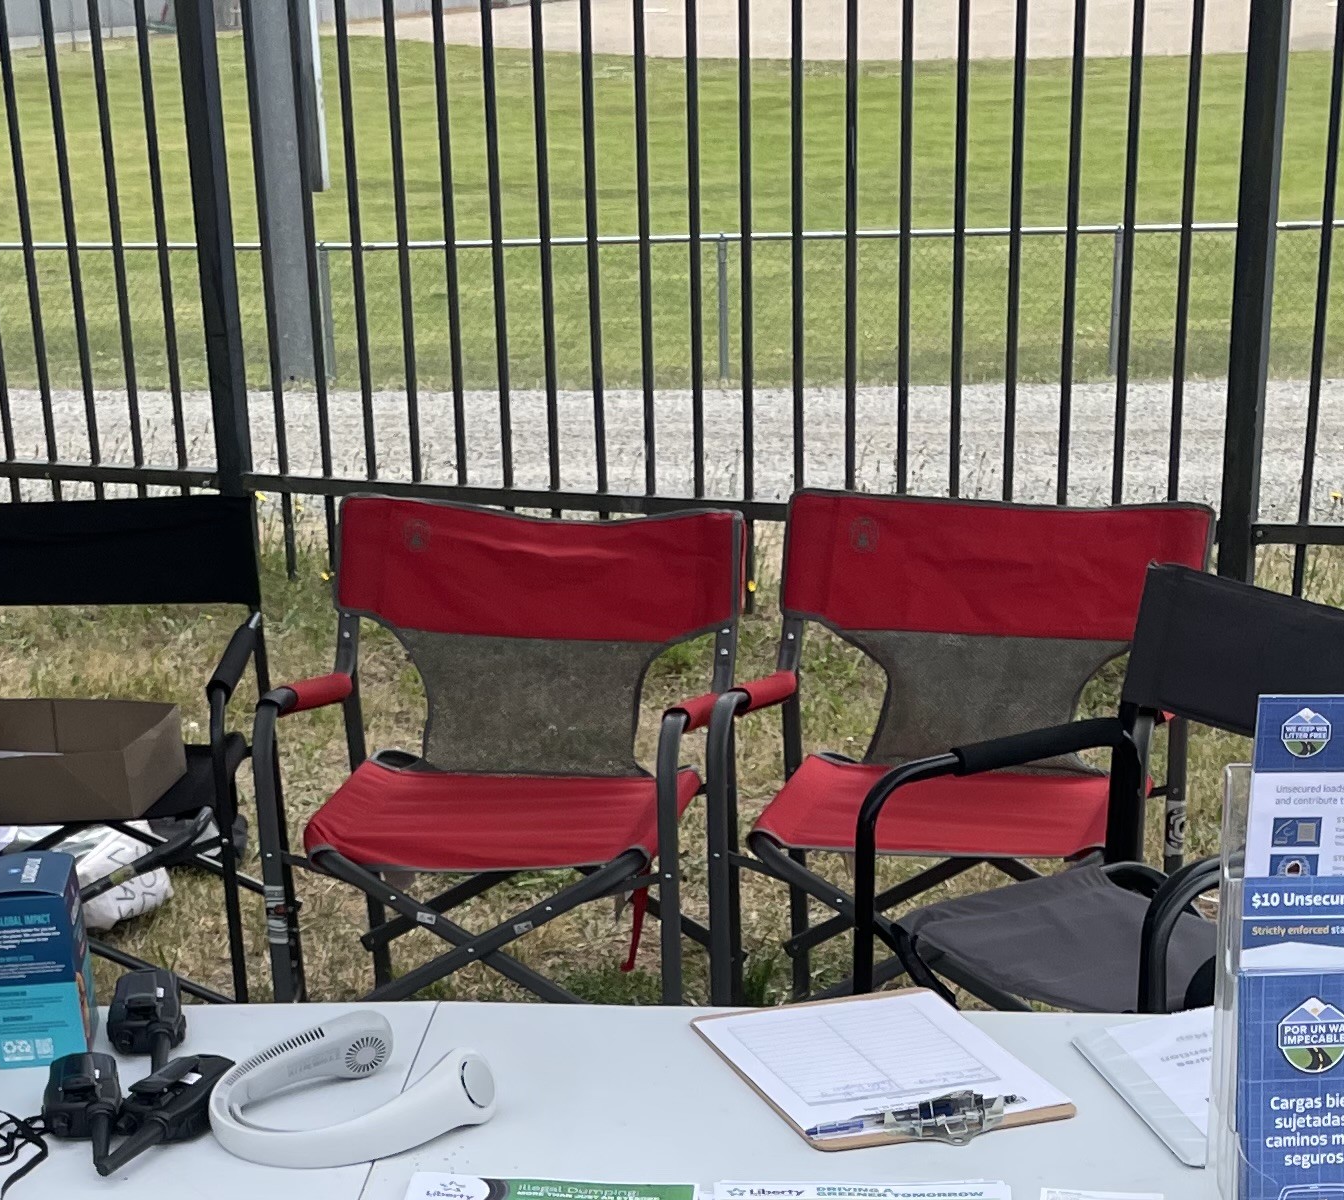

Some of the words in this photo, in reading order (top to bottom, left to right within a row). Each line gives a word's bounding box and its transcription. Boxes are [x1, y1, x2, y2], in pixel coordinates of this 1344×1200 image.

[1275, 785, 1322, 794] Unsecured
[1275, 797, 1291, 805] and
[1293, 797, 1338, 805] contribute
[1252, 893, 1280, 908] $10
[1252, 925, 1286, 937] Strictly
[1287, 924, 1329, 936] enforced
[1283, 1025, 1307, 1034] POR
[1310, 1025, 1325, 1034] UN
[1270, 1096, 1323, 1113] Cargas
[1265, 1133, 1327, 1148] caminos
[1283, 1152, 1344, 1169] seguros
[518, 1184, 562, 1195] Illegal
[749, 1188, 805, 1197] Liberty
